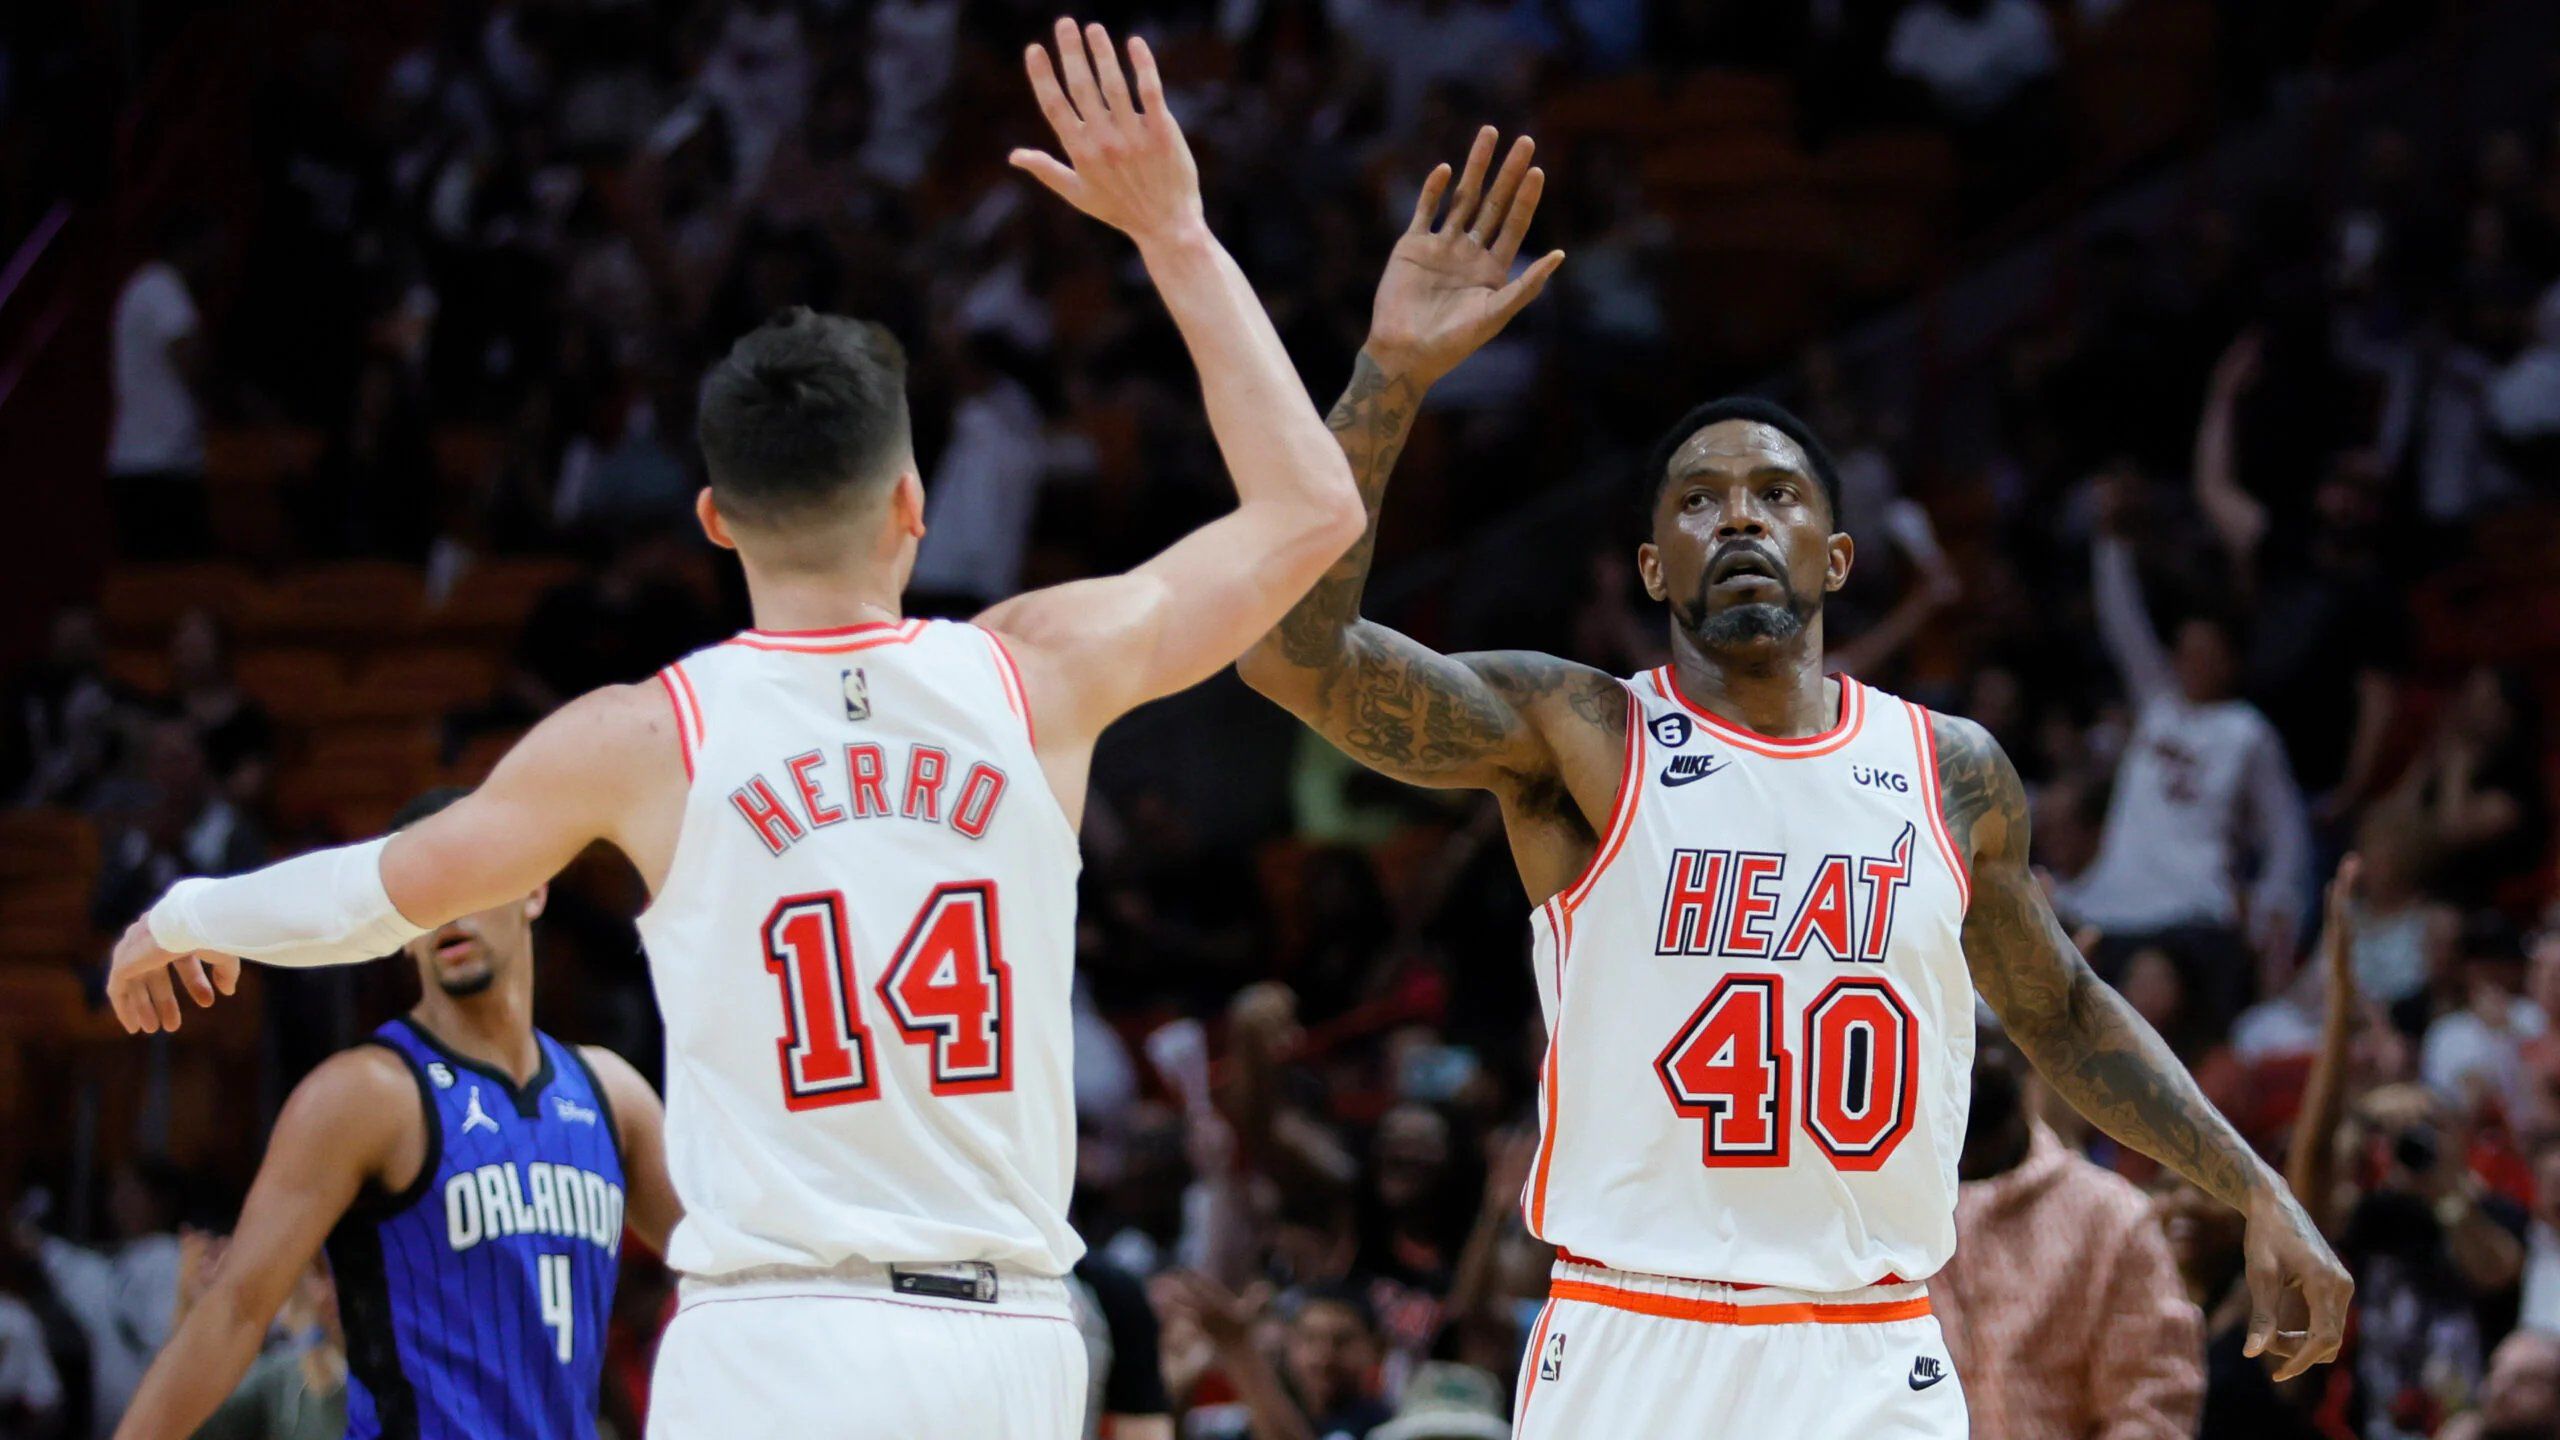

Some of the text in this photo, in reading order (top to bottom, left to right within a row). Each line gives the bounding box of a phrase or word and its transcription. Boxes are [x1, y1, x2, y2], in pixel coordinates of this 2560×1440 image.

[1656, 718, 1682, 744] 6
[1669, 755, 1714, 775] NIKE
[729, 742, 1008, 856] HERRO
[1655, 821, 1915, 963] HEAT
[761, 879, 1013, 1112] 14
[1653, 972, 1919, 1171] 40
[445, 1162, 624, 1259] ORLANDO
[538, 1254, 573, 1364] 4
[1914, 1355, 1940, 1378] NIKE
